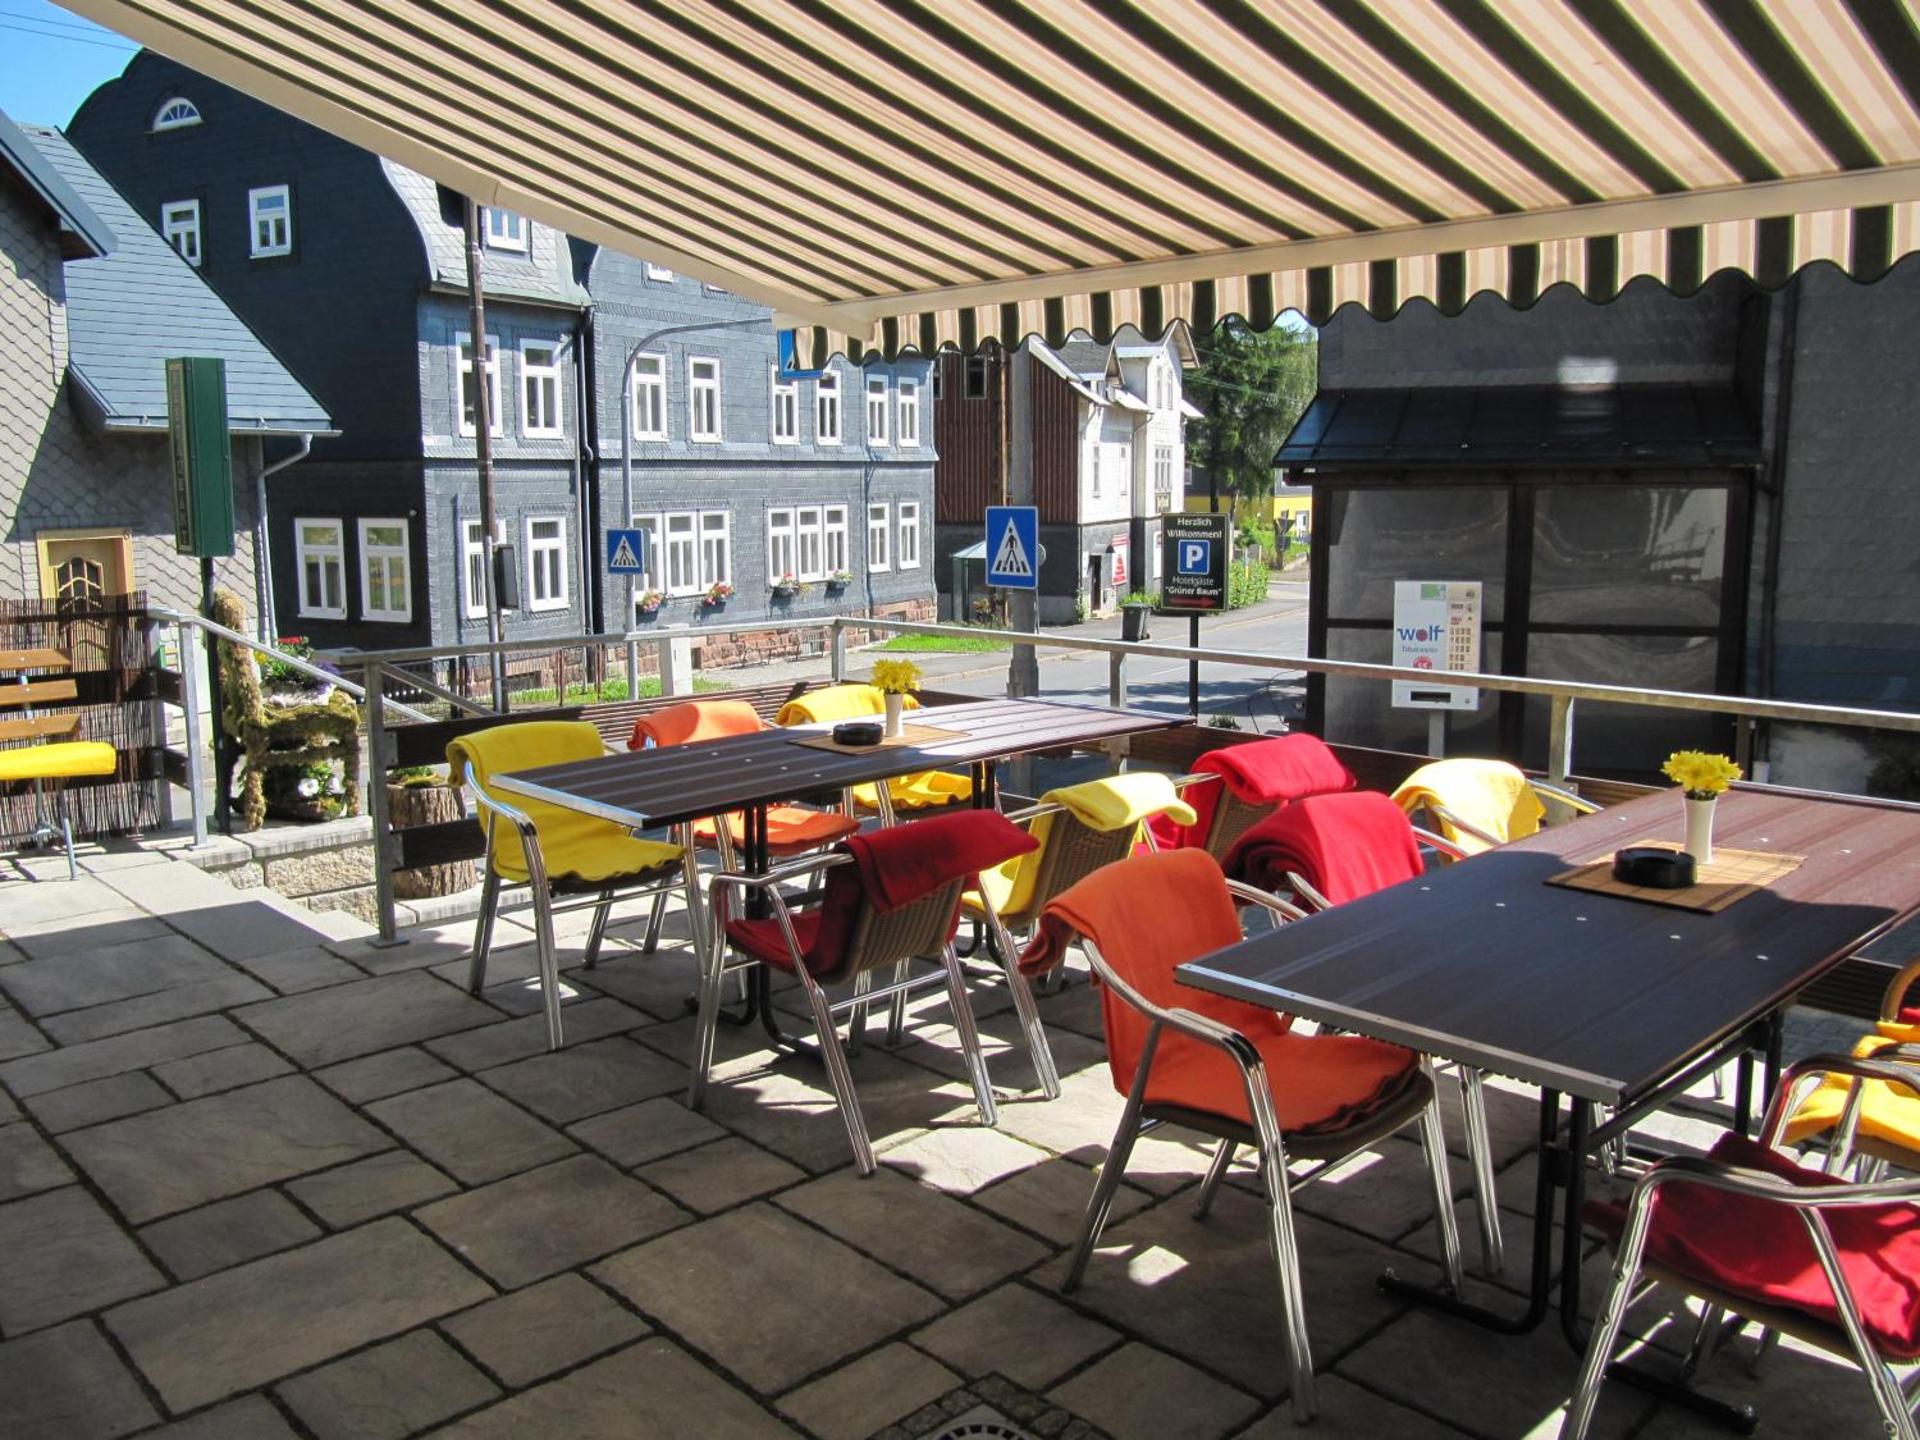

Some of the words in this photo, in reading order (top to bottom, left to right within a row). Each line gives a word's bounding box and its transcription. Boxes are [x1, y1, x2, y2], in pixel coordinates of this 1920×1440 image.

[1177, 517, 1212, 527] Herzlich
[1167, 529, 1222, 539] Willkommen!
[1186, 544, 1204, 569] P
[1397, 625, 1445, 642] wolf
